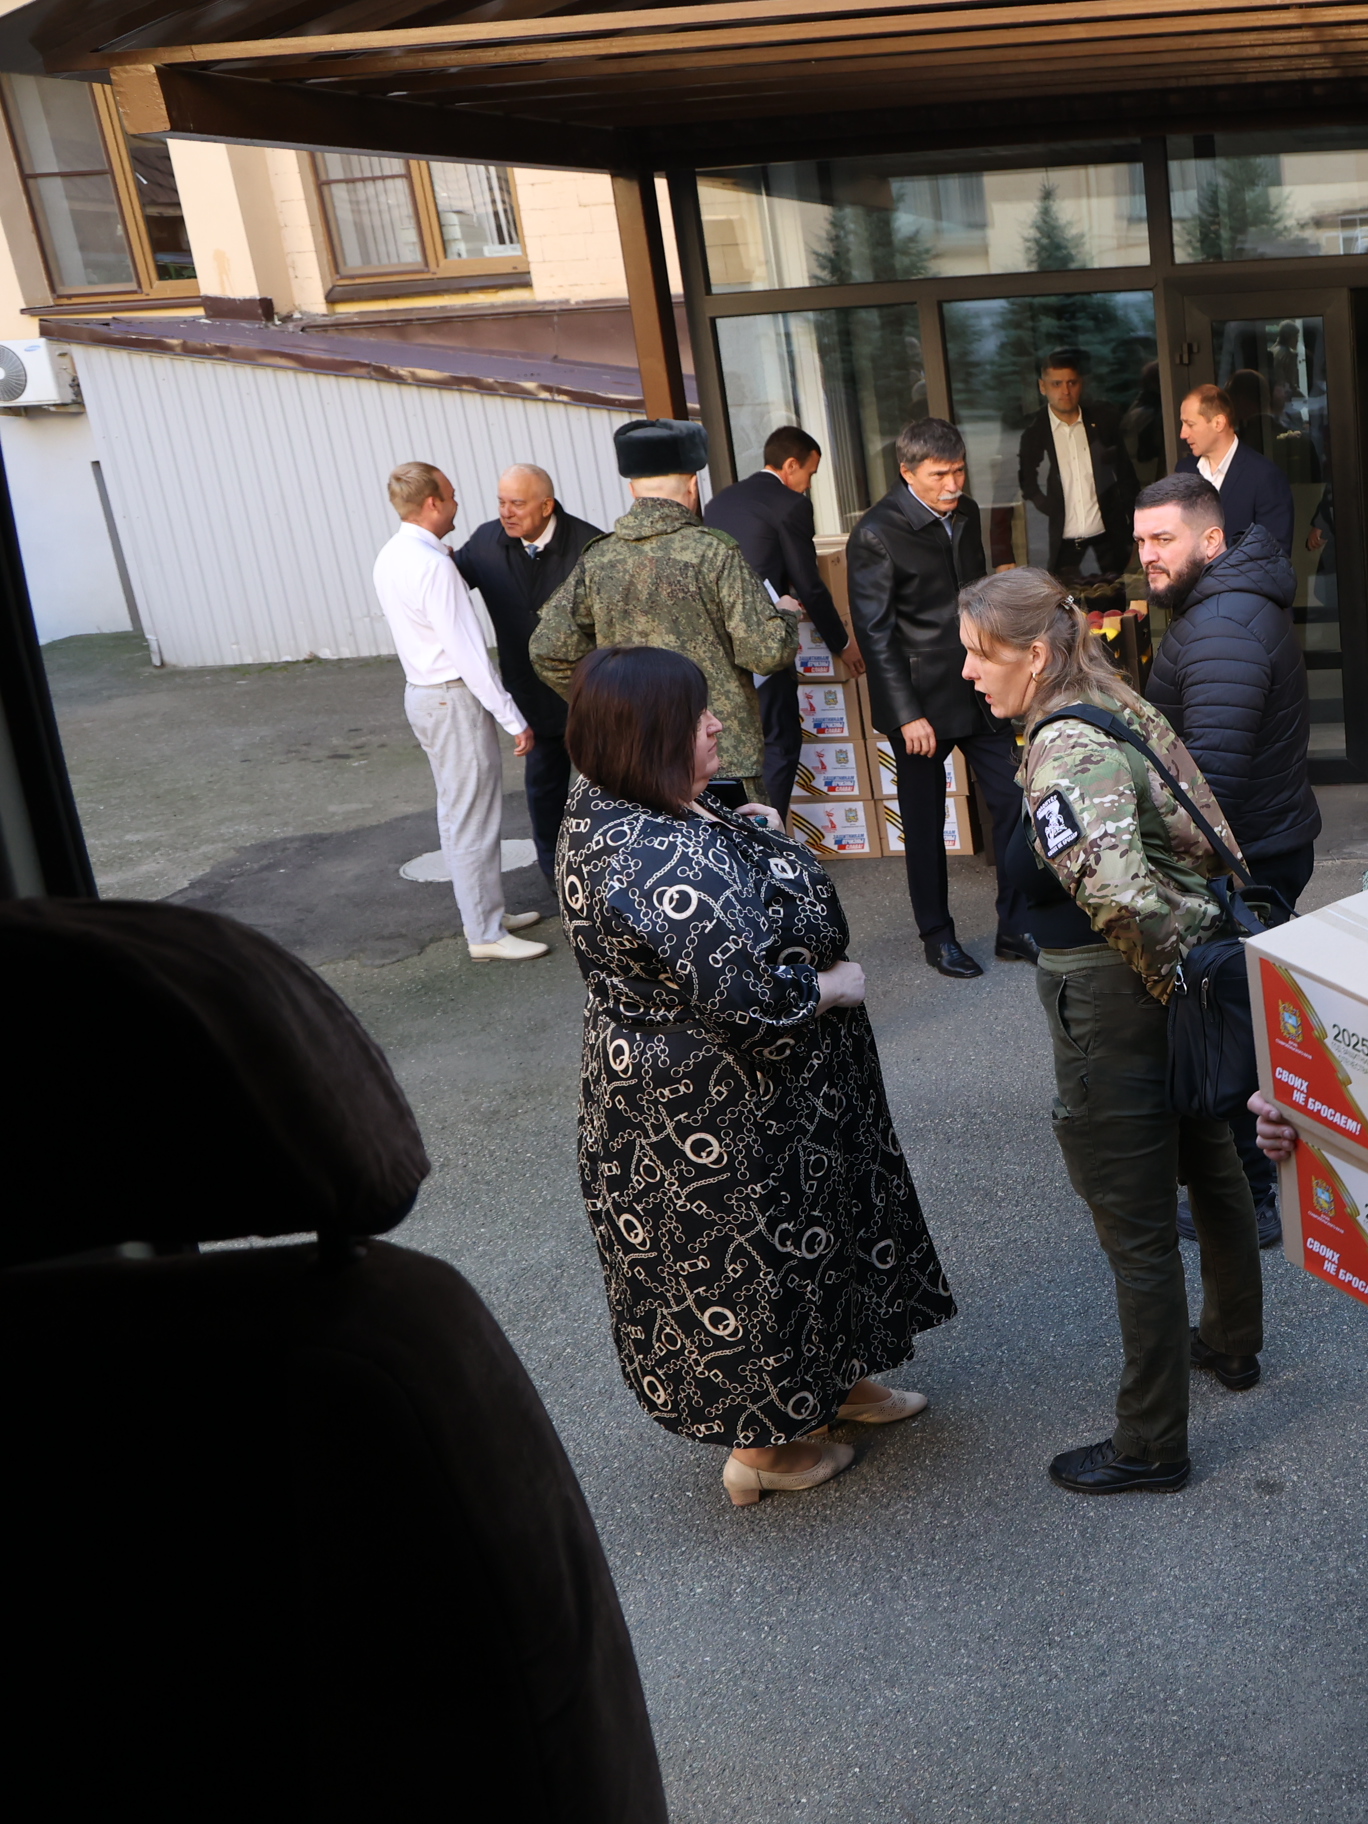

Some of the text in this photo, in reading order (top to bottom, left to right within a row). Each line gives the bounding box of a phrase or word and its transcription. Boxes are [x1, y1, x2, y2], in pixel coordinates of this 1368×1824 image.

[1275, 1066, 1310, 1093] СВОИХ
[1292, 1090, 1362, 1135] НЕ БРОСАЕМ!
[1306, 1237, 1340, 1264] СВОИХ
[1323, 1260, 1337, 1276] НЕ
